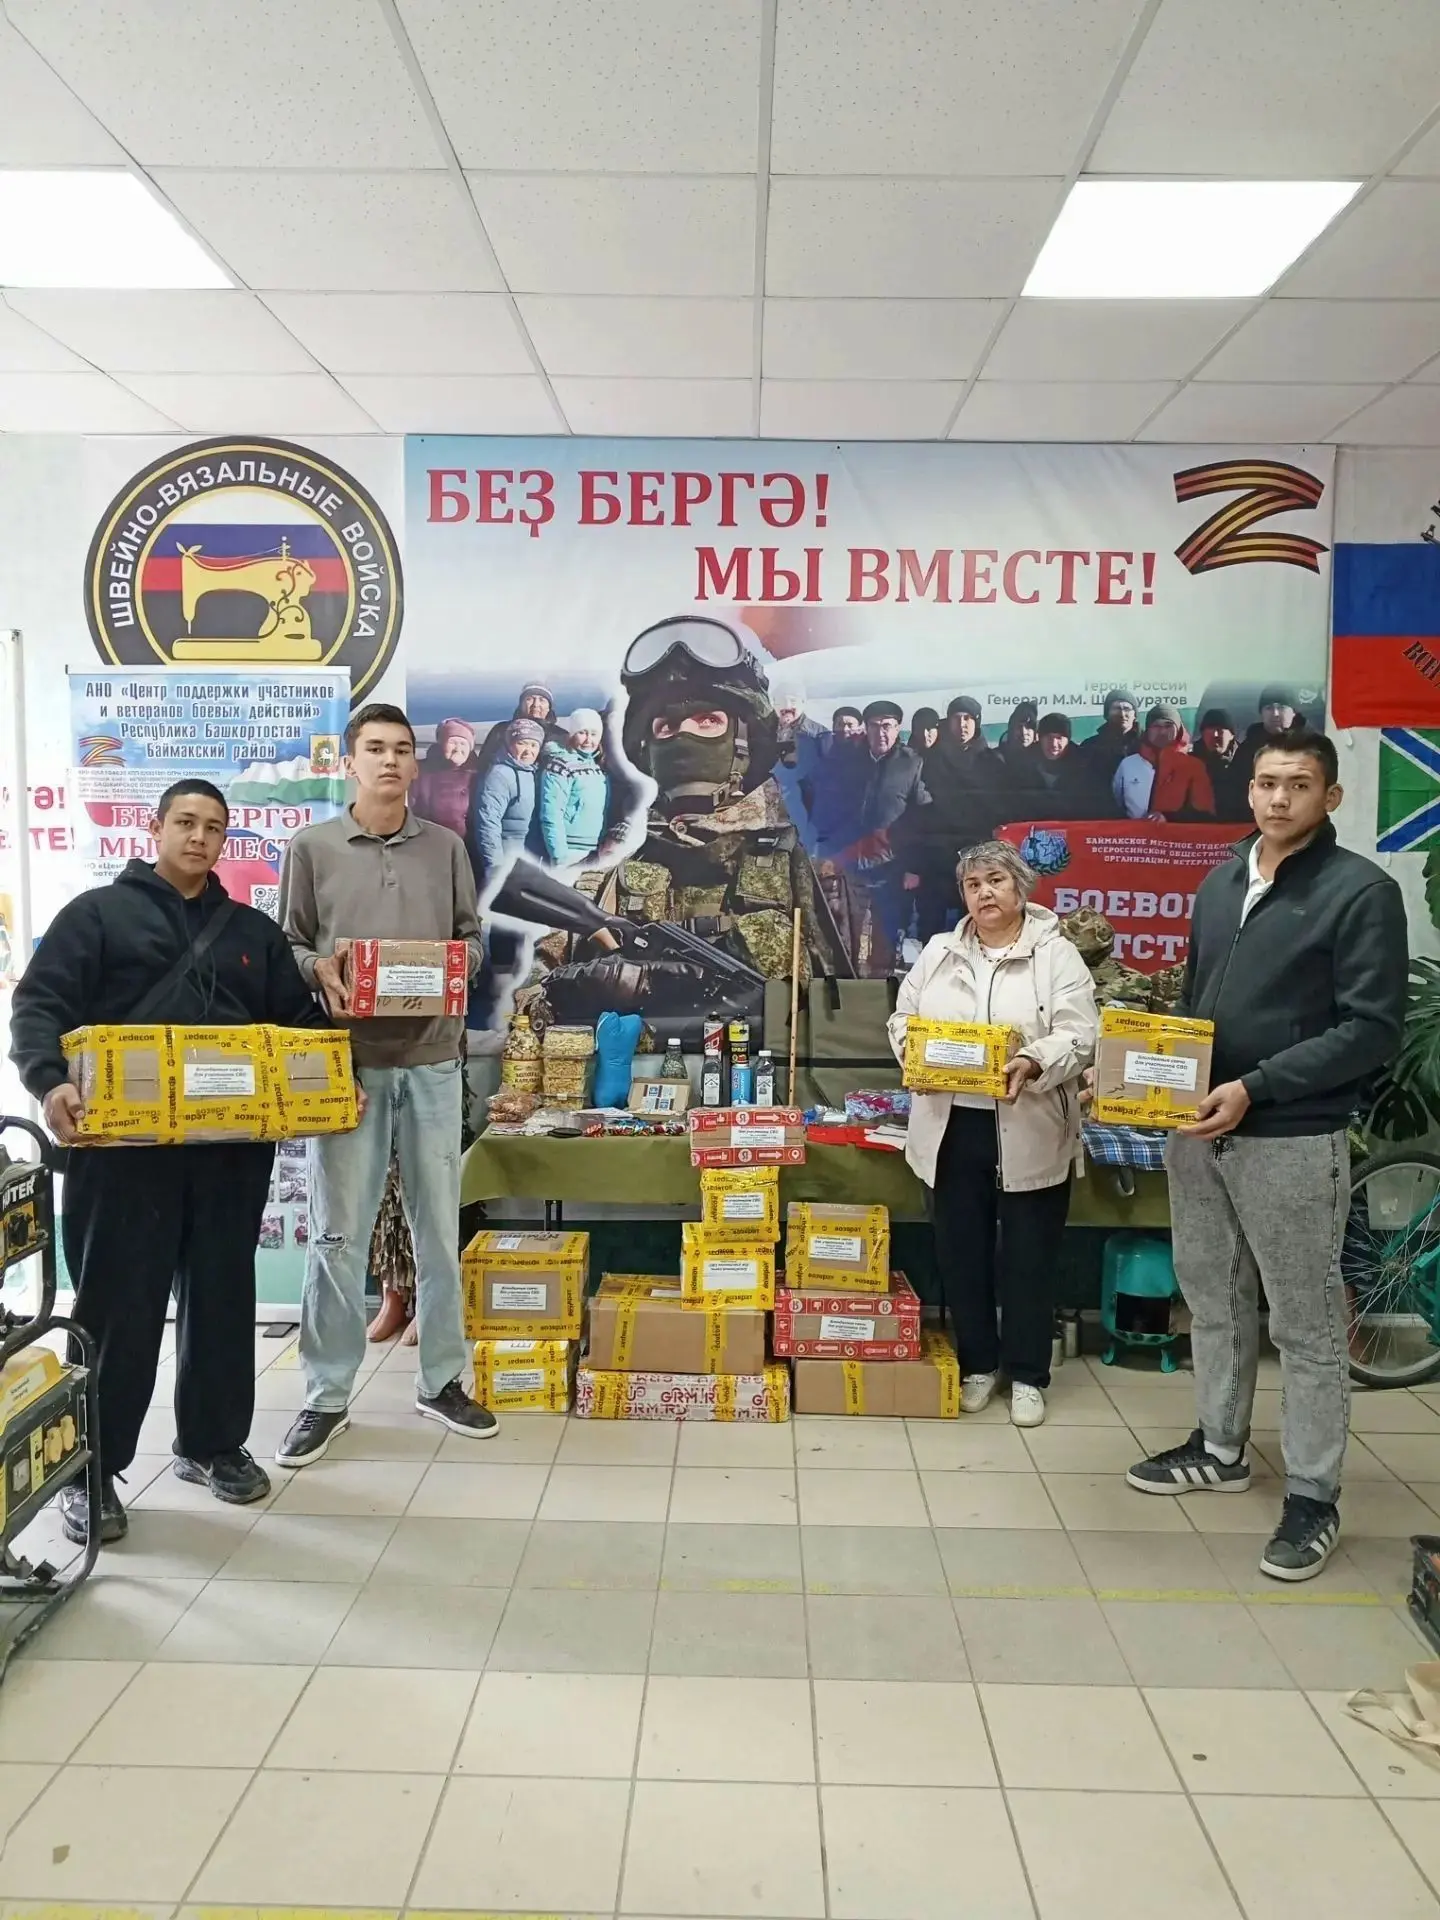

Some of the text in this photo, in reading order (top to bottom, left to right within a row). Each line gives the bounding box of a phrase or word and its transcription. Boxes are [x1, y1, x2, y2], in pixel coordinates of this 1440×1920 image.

[577, 471, 829, 528] БЕРГӘ!
[109, 461, 386, 638] ШВЕЙНО-ВЯЗАЛЬНЫЕ ВОЙСКА
[694, 546, 1157, 605] МЫ ВМЕСТЕ!
[86, 682, 334, 701] АНО «Центр поддержки участников
[1133, 680, 1188, 691] России
[1053, 694, 1087, 705] М.М.
[100, 703, 320, 719] и ветеранов боевых действий»
[121, 723, 301, 739] Республика Башкортостан
[147, 742, 276, 761] Баймакский район
[228, 806, 312, 829] ЕРГӘ!
[99, 837, 154, 859] МЫ
[1086, 837, 1147, 845] БАЙМАКСКОЕ
[1150, 839, 1193, 849] МЕСТНОЕ
[1104, 855, 1226, 866] ОРГАНИЗАЦИИ ВЕТЕРАНО
[1169, 850, 1237, 858] ОБЩЕСТВЕНН
[1054, 887, 1196, 918] БОЕВО
[102, 1118, 140, 1129] возврат
[297, 1116, 331, 1124] возврат
